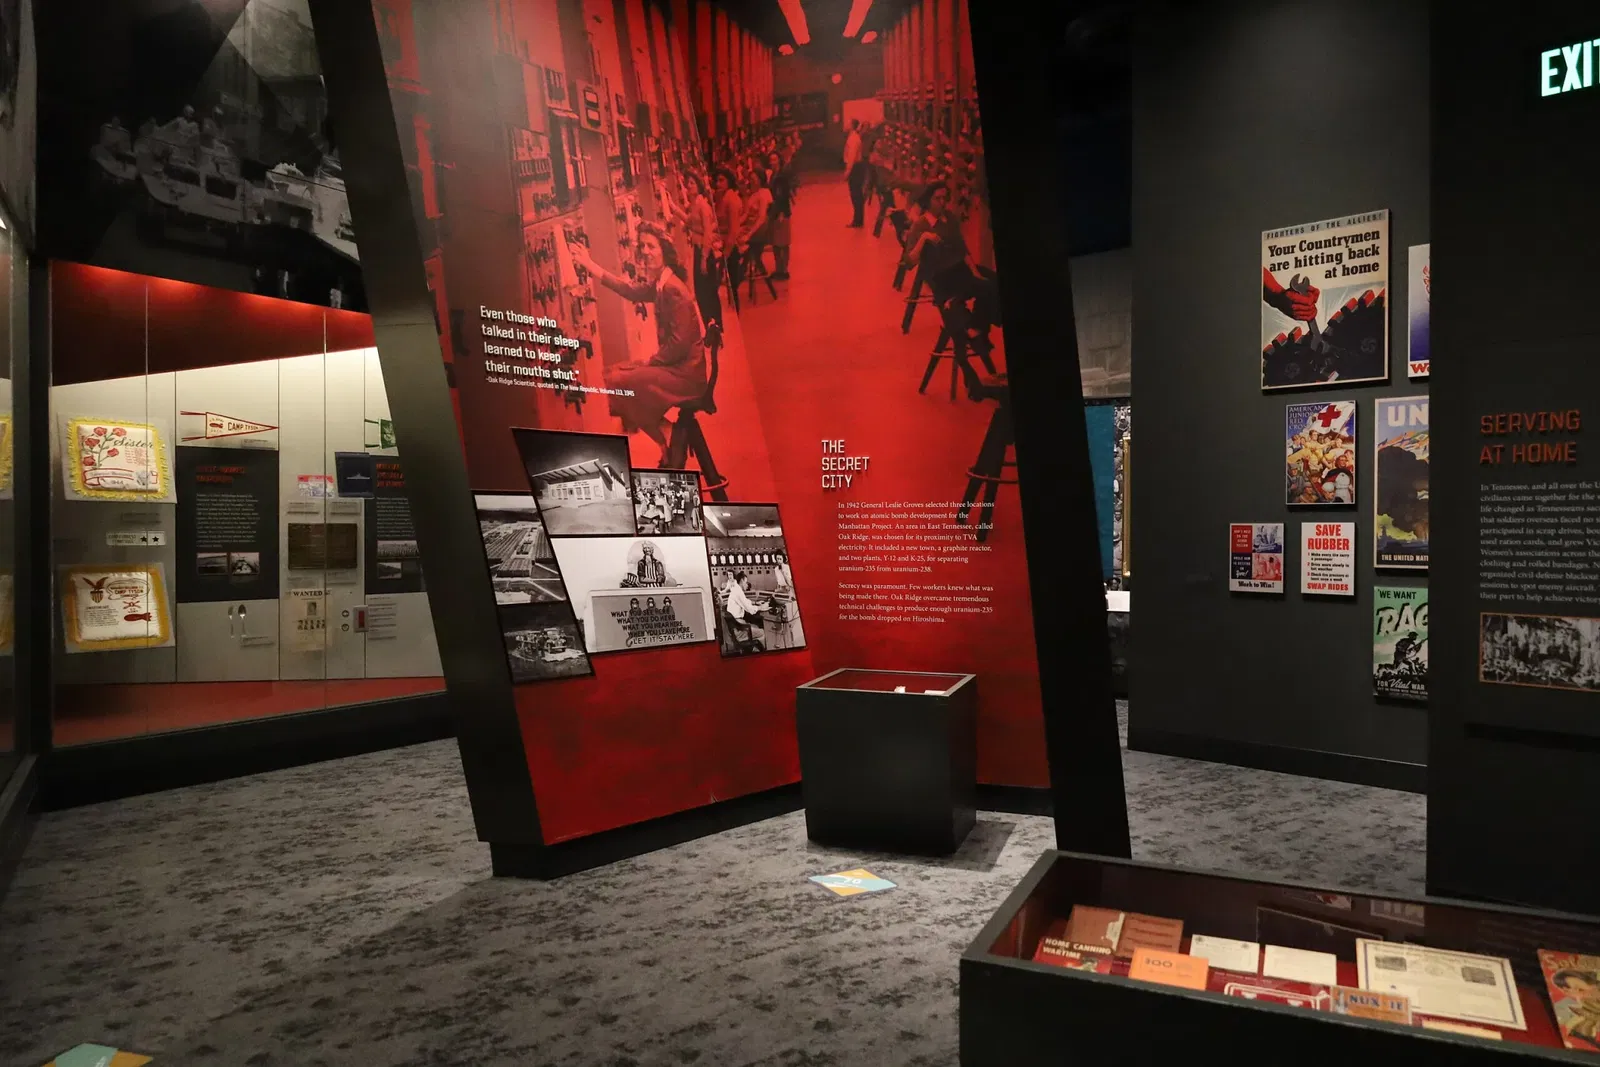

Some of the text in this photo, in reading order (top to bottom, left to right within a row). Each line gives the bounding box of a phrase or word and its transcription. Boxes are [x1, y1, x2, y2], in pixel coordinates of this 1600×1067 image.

[1266, 212, 1384, 240] FIGHTERS OF THE ALLIES!
[1268, 230, 1380, 258] Your Countrymen
[1269, 244, 1380, 272] are hitting back
[1324, 262, 1379, 279] at home
[480, 305, 557, 329] Even those who
[482, 324, 580, 349] talked in their sleep
[484, 342, 561, 364] learned to keep
[485, 360, 510, 374] their
[513, 366, 551, 378] mouths
[1289, 405, 1323, 413] AMERICAN
[228, 422, 244, 431] CAMP
[1480, 409, 1581, 434] SERVING
[113, 437, 153, 448] Sister
[821, 440, 845, 453] THE
[1479, 441, 1577, 464] AT HOME
[822, 457, 869, 471] SECRET
[822, 475, 852, 488] CITY
[1535, 494, 1566, 502] together
[1315, 524, 1341, 537] SAVE
[1307, 538, 1350, 551] RUBBER
[1328, 583, 1348, 591] RIDES
[1394, 591, 1416, 599] WANT
[622, 623, 639, 631] WHAT
[641, 622, 653, 630] YOU
[628, 630, 645, 638] WHEN
[659, 627, 677, 635] LEAVE
[633, 637, 647, 645] LET
[649, 636, 656, 644] IT
[1388, 678, 1412, 689] Vital
[1045, 938, 1111, 955] HOME CANNING
[1043, 947, 1081, 960] WARTIME
